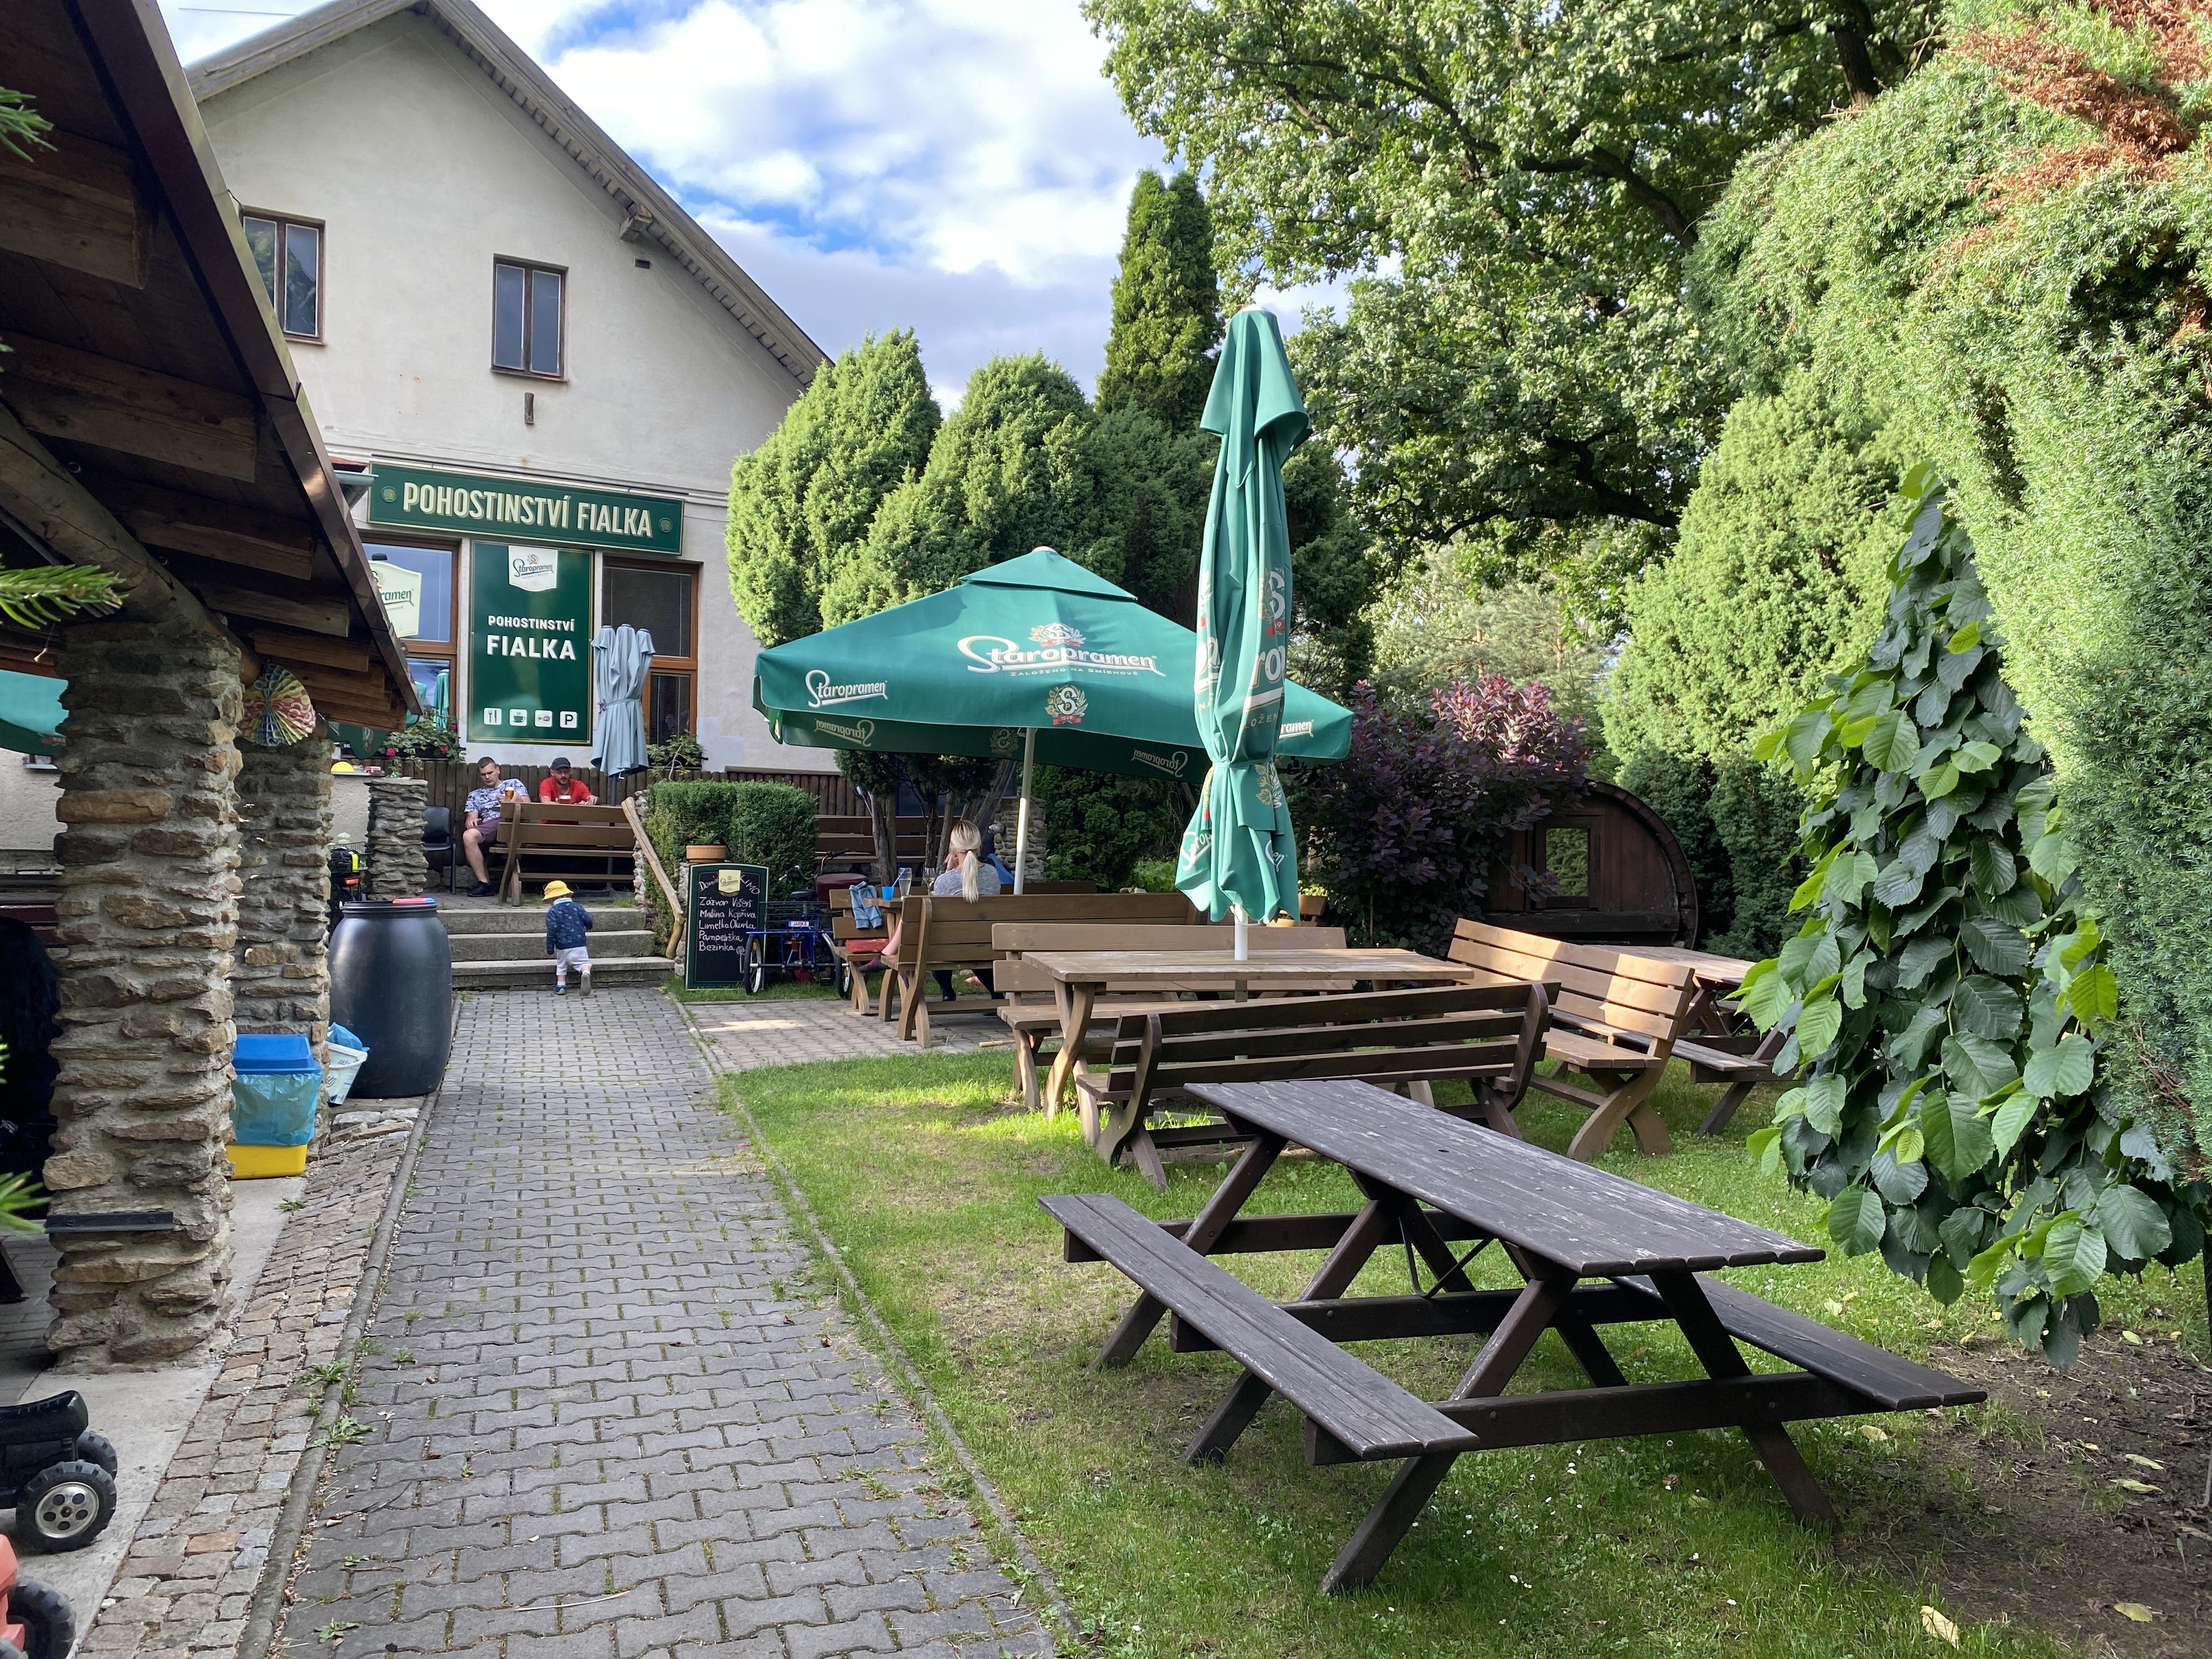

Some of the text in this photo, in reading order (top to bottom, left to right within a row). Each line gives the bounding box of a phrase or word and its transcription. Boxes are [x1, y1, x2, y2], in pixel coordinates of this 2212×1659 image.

[403, 482, 653, 538] POHOSTINSTVÍ FIALKA
[513, 559, 554, 577] Staropramen
[488, 615, 576, 632] POHOSTINSTVÍ
[487, 634, 577, 661] FIALKA
[957, 635, 1166, 677] Staropramen
[805, 670, 889, 708] Staropramen
[740, 874, 760, 895] LIMO
[699, 896, 728, 906] Zázvor
[699, 930, 743, 943] Pampeliška
[699, 941, 735, 951] Bezinka
